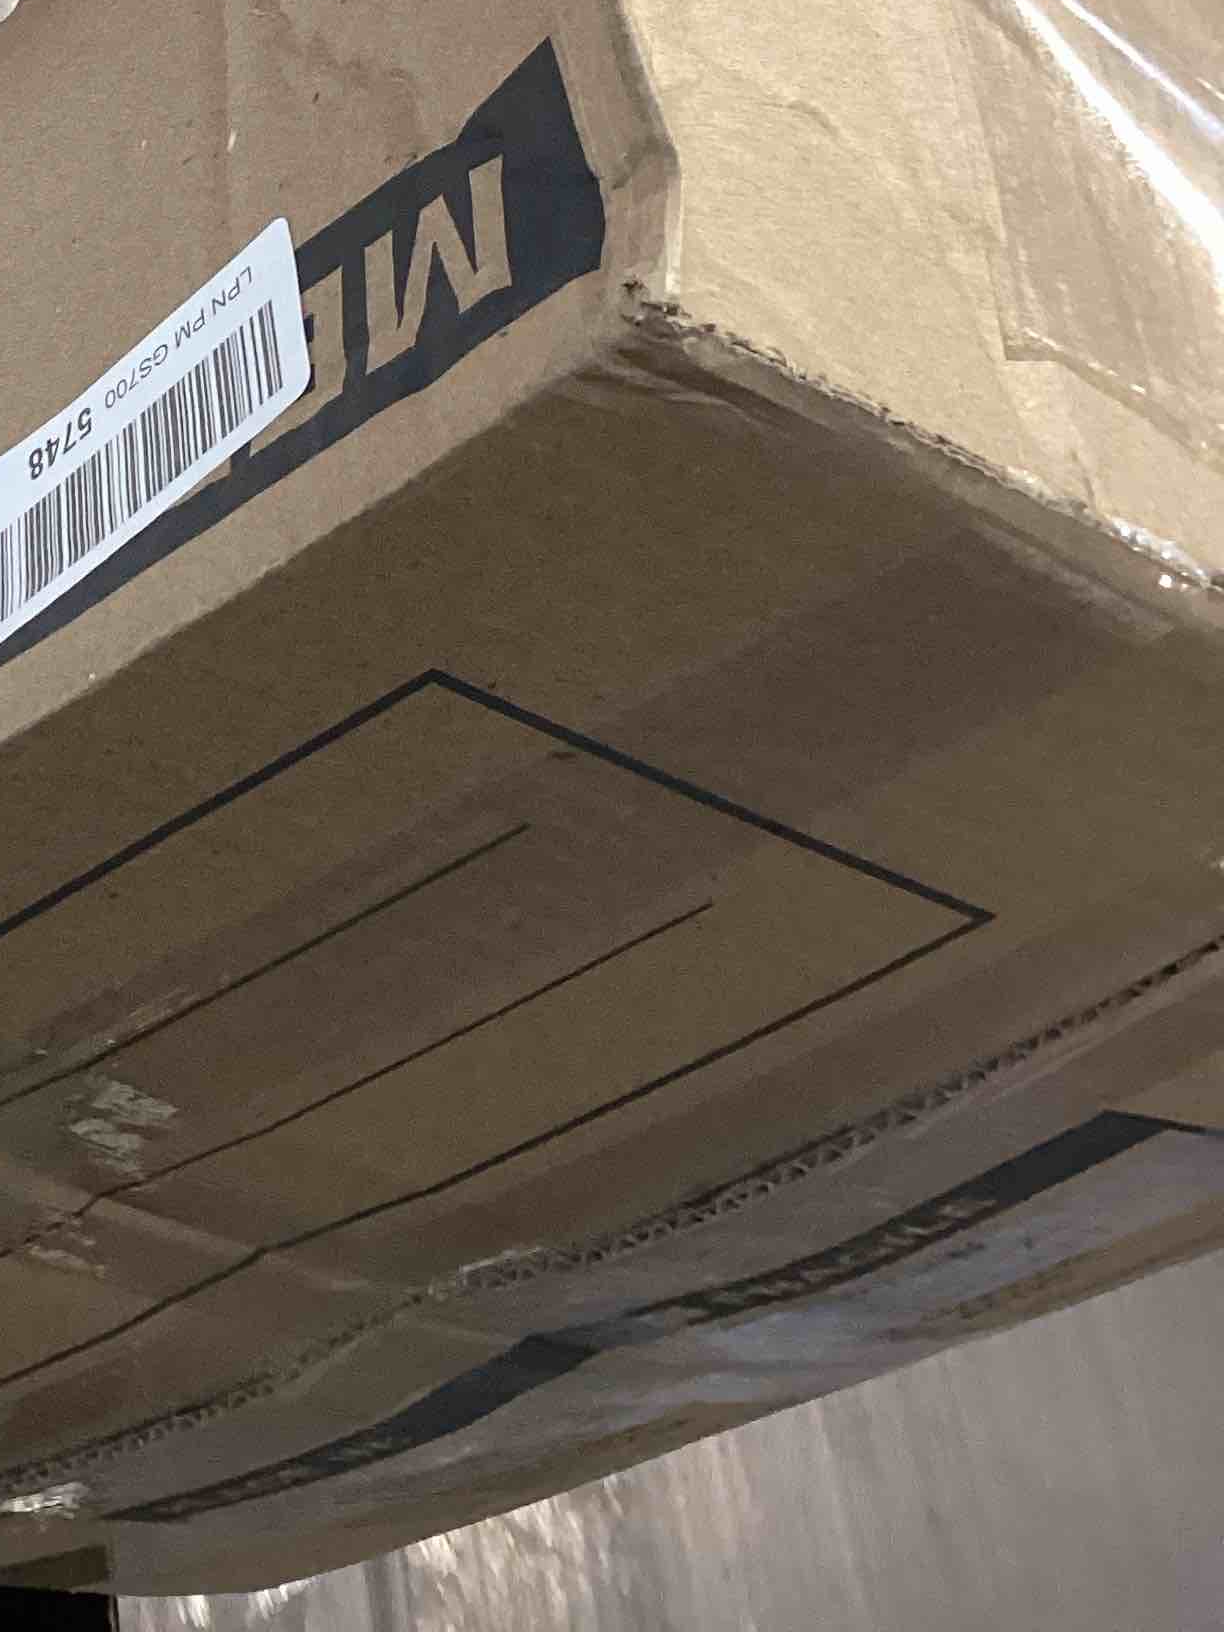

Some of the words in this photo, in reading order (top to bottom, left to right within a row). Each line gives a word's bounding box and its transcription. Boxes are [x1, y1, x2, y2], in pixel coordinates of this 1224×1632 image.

[210, 264, 255, 318] LPN
[174, 308, 206, 350] PM
[27, 406, 94, 481] 5748
